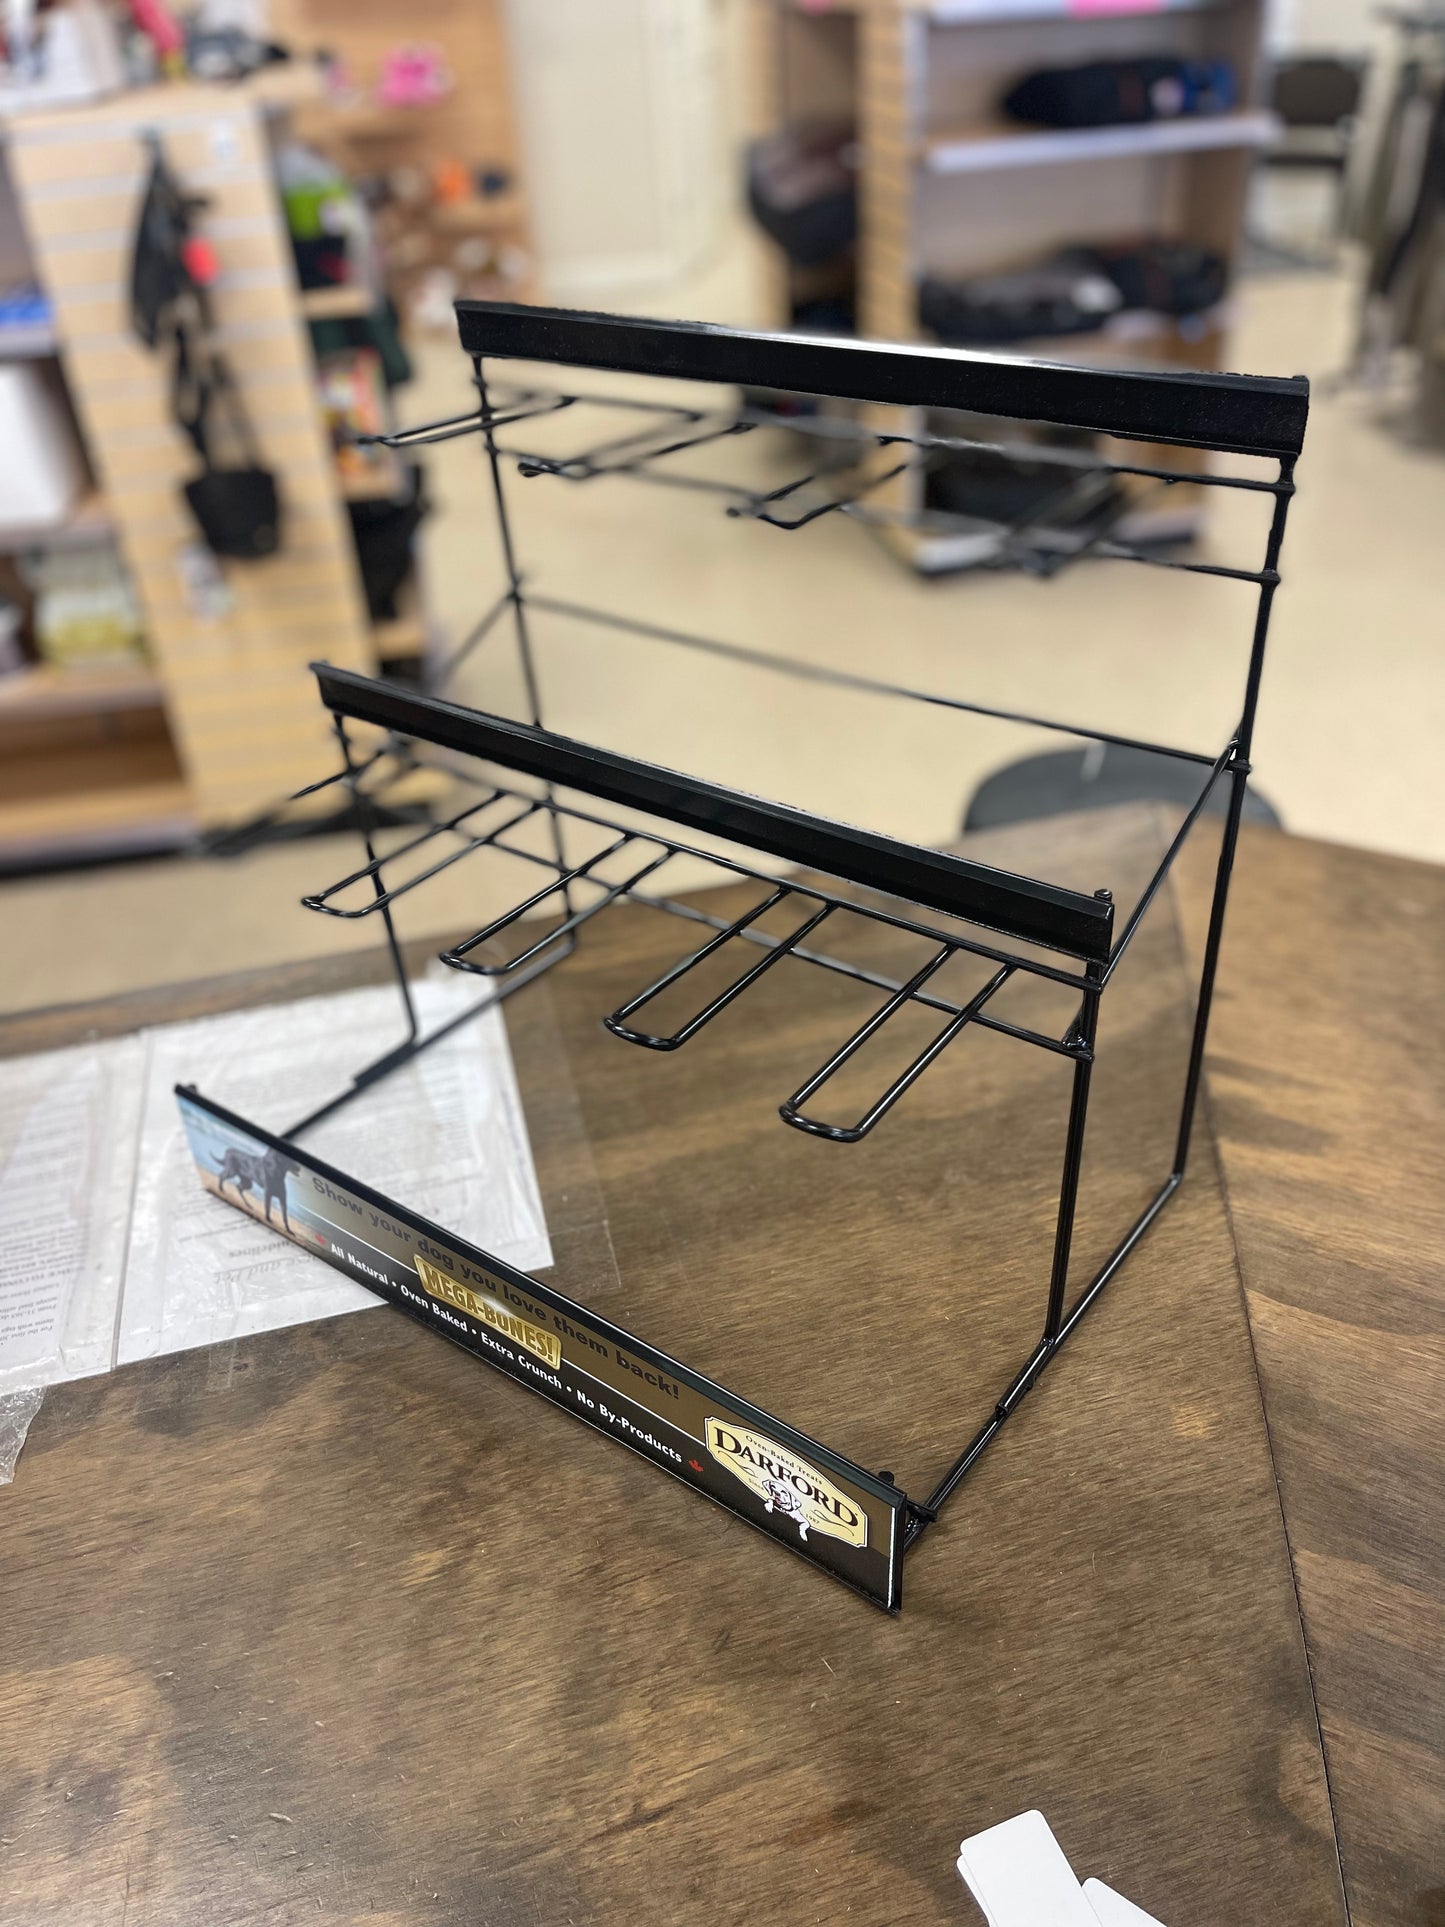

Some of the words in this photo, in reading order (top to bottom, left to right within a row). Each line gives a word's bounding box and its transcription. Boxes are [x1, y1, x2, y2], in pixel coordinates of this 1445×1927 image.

[311, 1177, 363, 1216] Show
[369, 1212, 412, 1242] your
[417, 1239, 455, 1272] dog
[460, 1263, 497, 1293] you
[503, 1284, 547, 1321] love
[553, 1315, 609, 1359] them
[615, 1349, 680, 1400] back!
[422, 1263, 555, 1363] MEGA-BONES!
[331, 1243, 345, 1259] All
[347, 1252, 389, 1285] Natural
[400, 1284, 429, 1309] Oven
[432, 1302, 468, 1333] Baked
[480, 1331, 515, 1361] Extra
[517, 1355, 563, 1390] Crunch
[576, 1389, 595, 1409] No
[599, 1403, 683, 1463] By-Products
[714, 1426, 859, 1527] DARFORD
[745, 1434, 796, 1469] Oven-Baked
[797, 1465, 823, 1486] Treats
